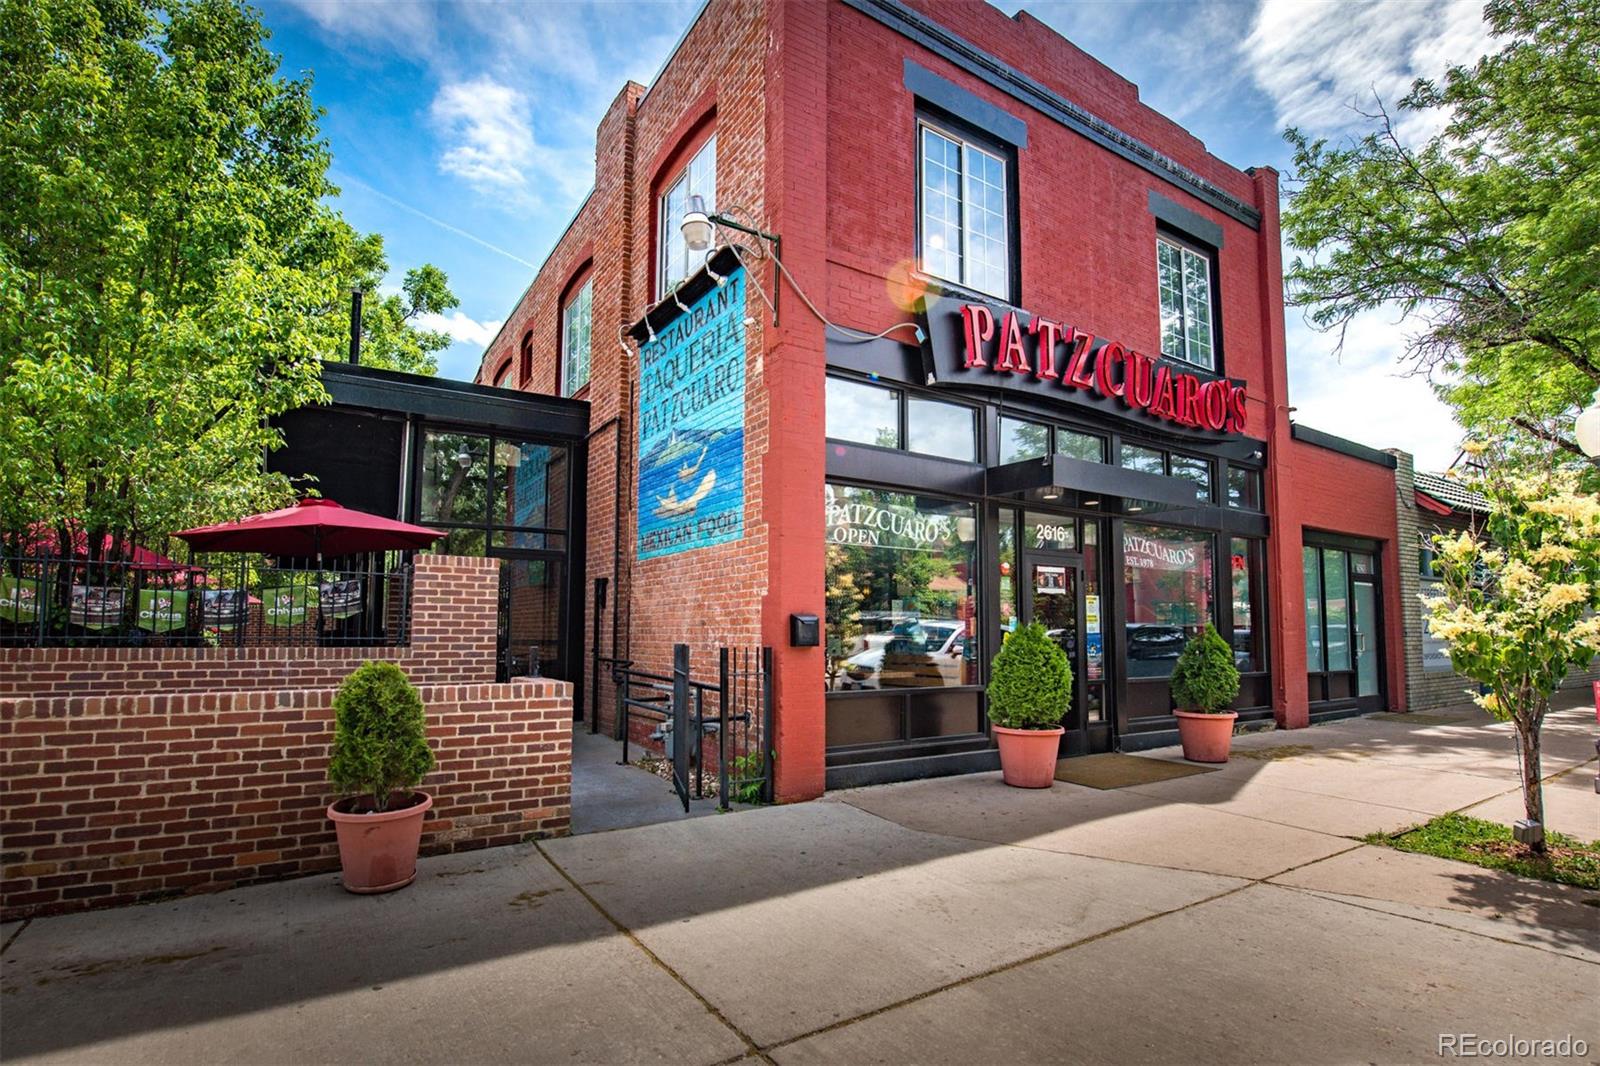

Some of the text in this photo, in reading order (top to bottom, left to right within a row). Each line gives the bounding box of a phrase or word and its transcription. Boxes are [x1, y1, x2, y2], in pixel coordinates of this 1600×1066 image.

[644, 279, 739, 369] RESTAURANT
[642, 312, 741, 404] TAQUERIA
[960, 304, 1248, 434] PATZCUARO'S
[641, 356, 740, 439] PATZCUARO
[641, 509, 739, 552] MEXICAN FOOD
[827, 503, 952, 543] PATZCUARO'S
[833, 526, 881, 545] OPEN
[1036, 524, 1066, 541] 2616
[1123, 536, 1195, 565] PATZCUARO'S
